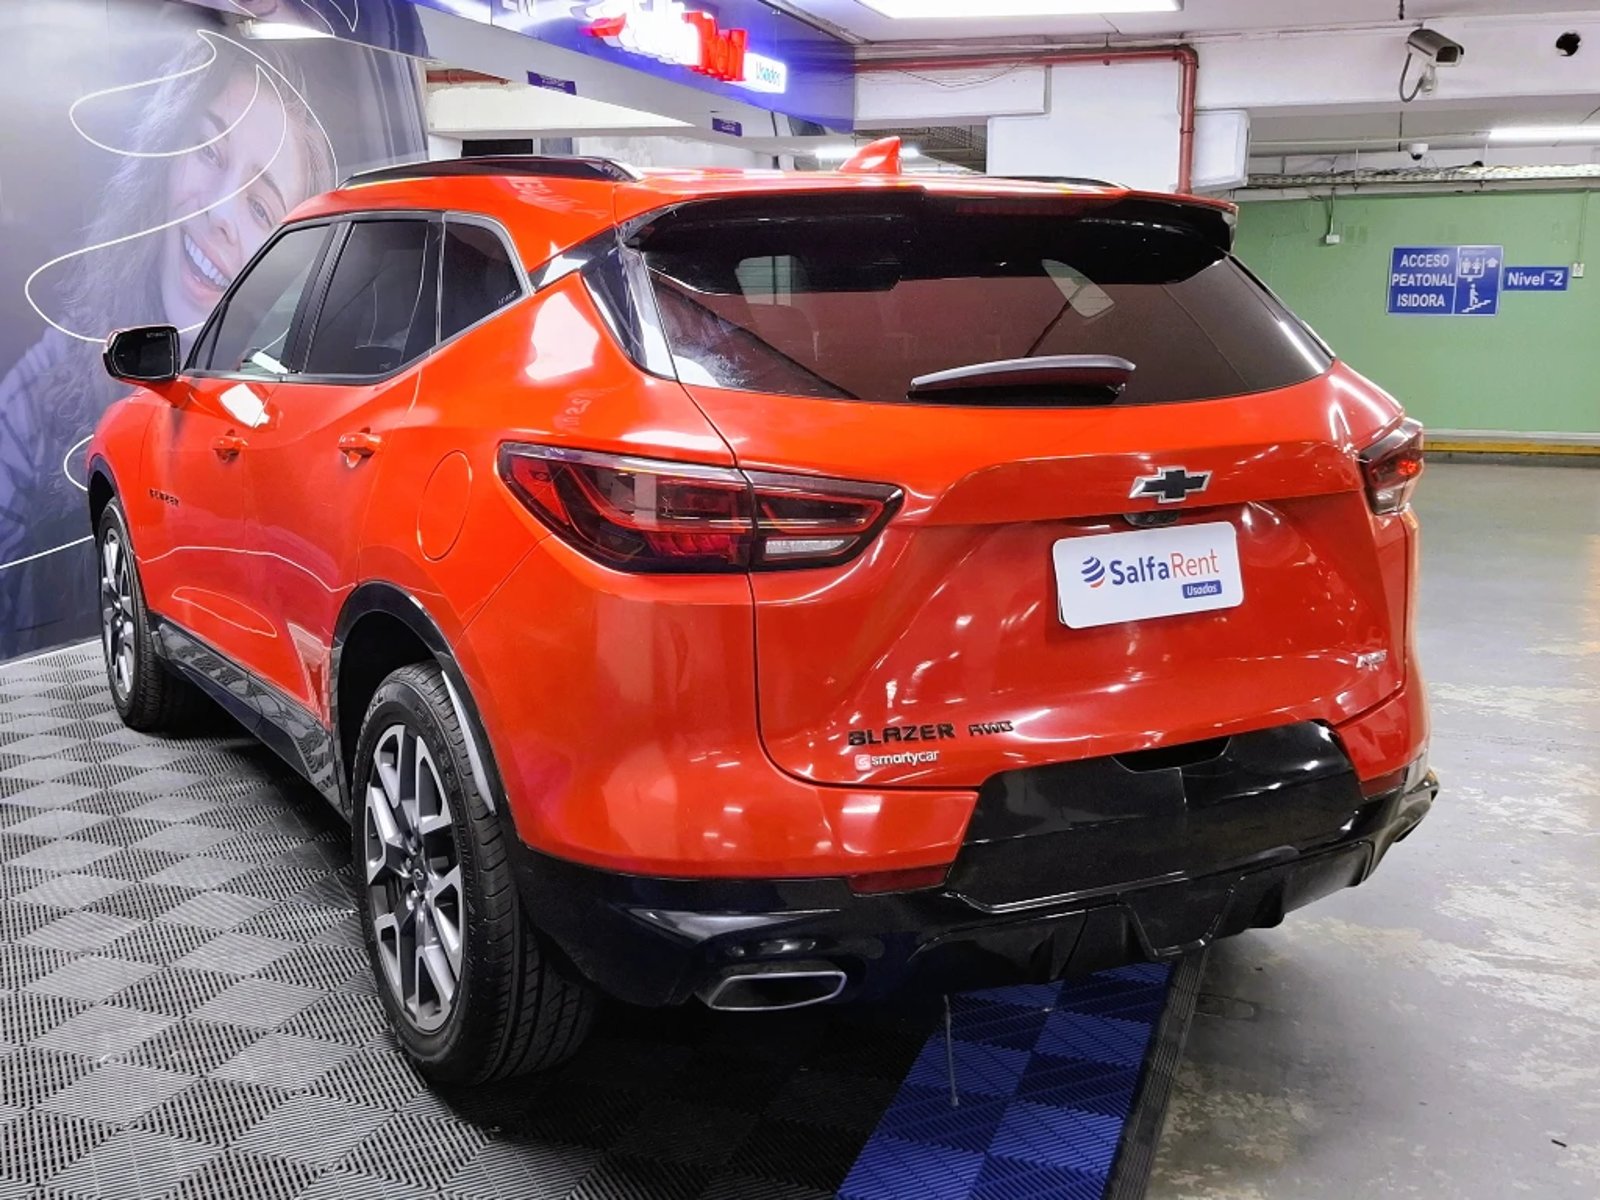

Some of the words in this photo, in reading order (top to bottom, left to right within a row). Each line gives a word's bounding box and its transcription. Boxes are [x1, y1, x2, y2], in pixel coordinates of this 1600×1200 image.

[1400, 254, 1449, 268] ACCESO
[1391, 273, 1455, 287] PEATONAL
[1507, 272, 1545, 286] Nivel
[1548, 273, 1564, 286] -2
[1396, 294, 1445, 307] ISIDORA
[1109, 549, 1220, 586] SalfaRent
[1186, 583, 1218, 597] Usados
[848, 723, 956, 746] BLAZER
[968, 720, 1014, 737] AWD
[871, 750, 940, 766] smartycar
